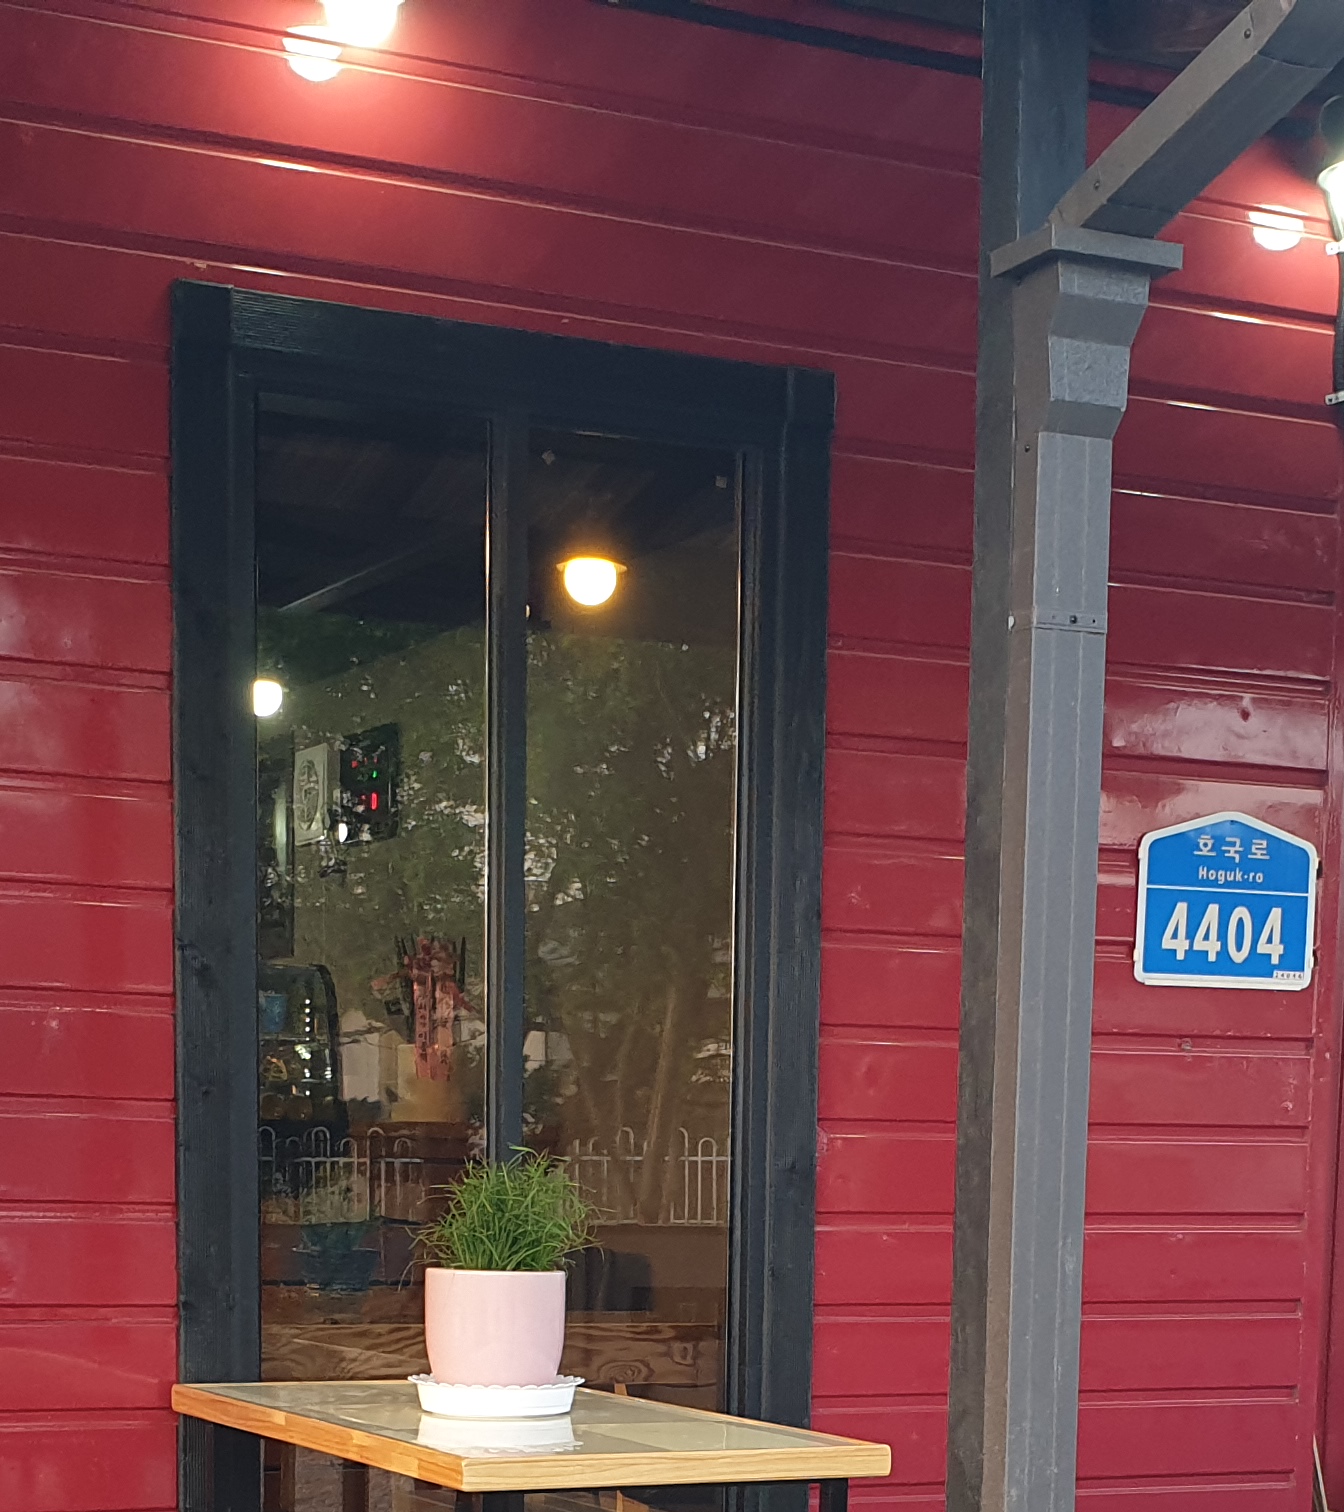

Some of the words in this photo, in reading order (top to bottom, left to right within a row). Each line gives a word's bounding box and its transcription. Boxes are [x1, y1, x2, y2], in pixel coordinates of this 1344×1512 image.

[1193, 835, 1271, 864] 호국로
[1197, 865, 1265, 885] Hoguk-ro
[1161, 901, 1284, 966] 4404
